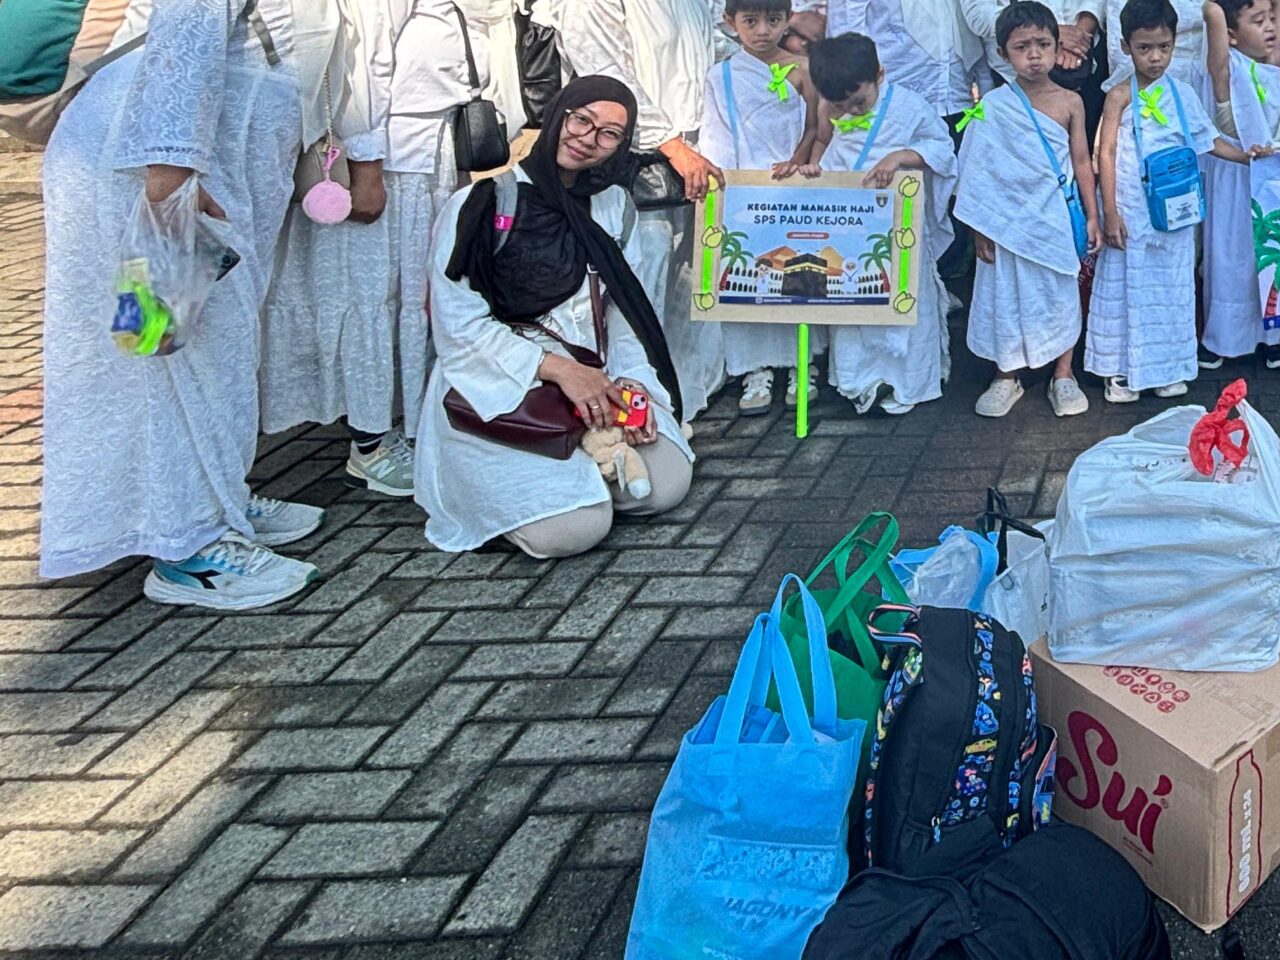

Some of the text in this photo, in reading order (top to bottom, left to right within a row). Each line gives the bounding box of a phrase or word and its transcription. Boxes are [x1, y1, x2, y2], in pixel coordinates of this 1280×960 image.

[747, 203, 875, 214] KEGIATAN MANASIK HAJI
[754, 214, 863, 226] SPS PAUD KEJORA
[1055, 710, 1173, 855] Sui
